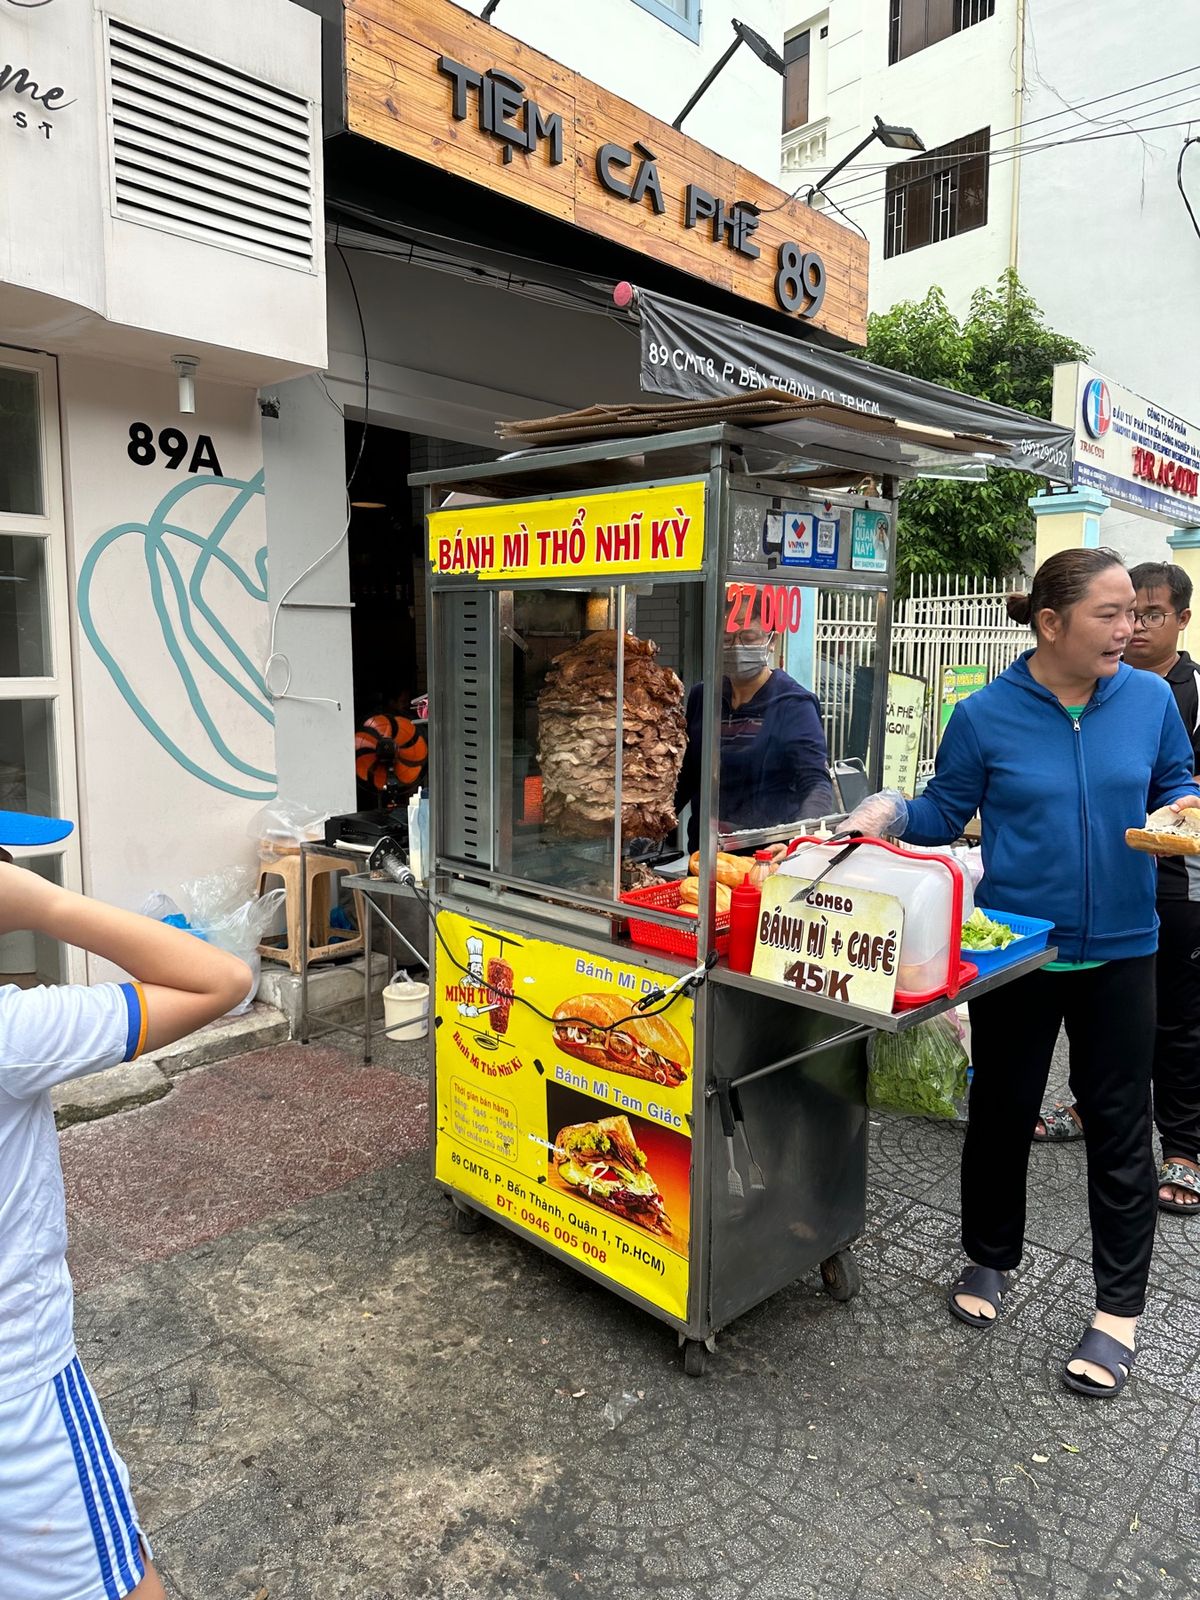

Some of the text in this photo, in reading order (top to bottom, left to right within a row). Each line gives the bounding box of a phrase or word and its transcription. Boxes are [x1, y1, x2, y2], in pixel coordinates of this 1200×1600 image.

[437, 55, 828, 318] TIỆM CÀ PHÊ 89
[649, 343, 669, 366] 89
[722, 363, 735, 384] P.
[127, 421, 224, 478] 89A
[1131, 445, 1200, 497] TRACODI
[438, 507, 691, 570] BÁNH MÌ THỔ NHĨ KỲ
[897, 705, 914, 720] PHÊ
[806, 892, 853, 913] COMBO
[759, 905, 897, 976] BÁNH MÌ + CAFÉ
[445, 978, 516, 1007] MINH TUẤN
[575, 959, 613, 983] Bánh
[618, 971, 636, 990] Mì
[452, 1031, 470, 1060] Bánh
[480, 1060, 497, 1078] Thổ
[499, 1062, 513, 1077] Nhĩ
[466, 1090, 478, 1103] gian
[480, 1096, 492, 1109] bán
[492, 1101, 509, 1118] hàng
[555, 1065, 683, 1128] Bánh Mì Tam Giác
[451, 1151, 666, 1276] 89 CMT8, P. Bến Thành, Quận 1, Tp.HCM)
[496, 1194, 607, 1264] ĐT: 0946 005 008
